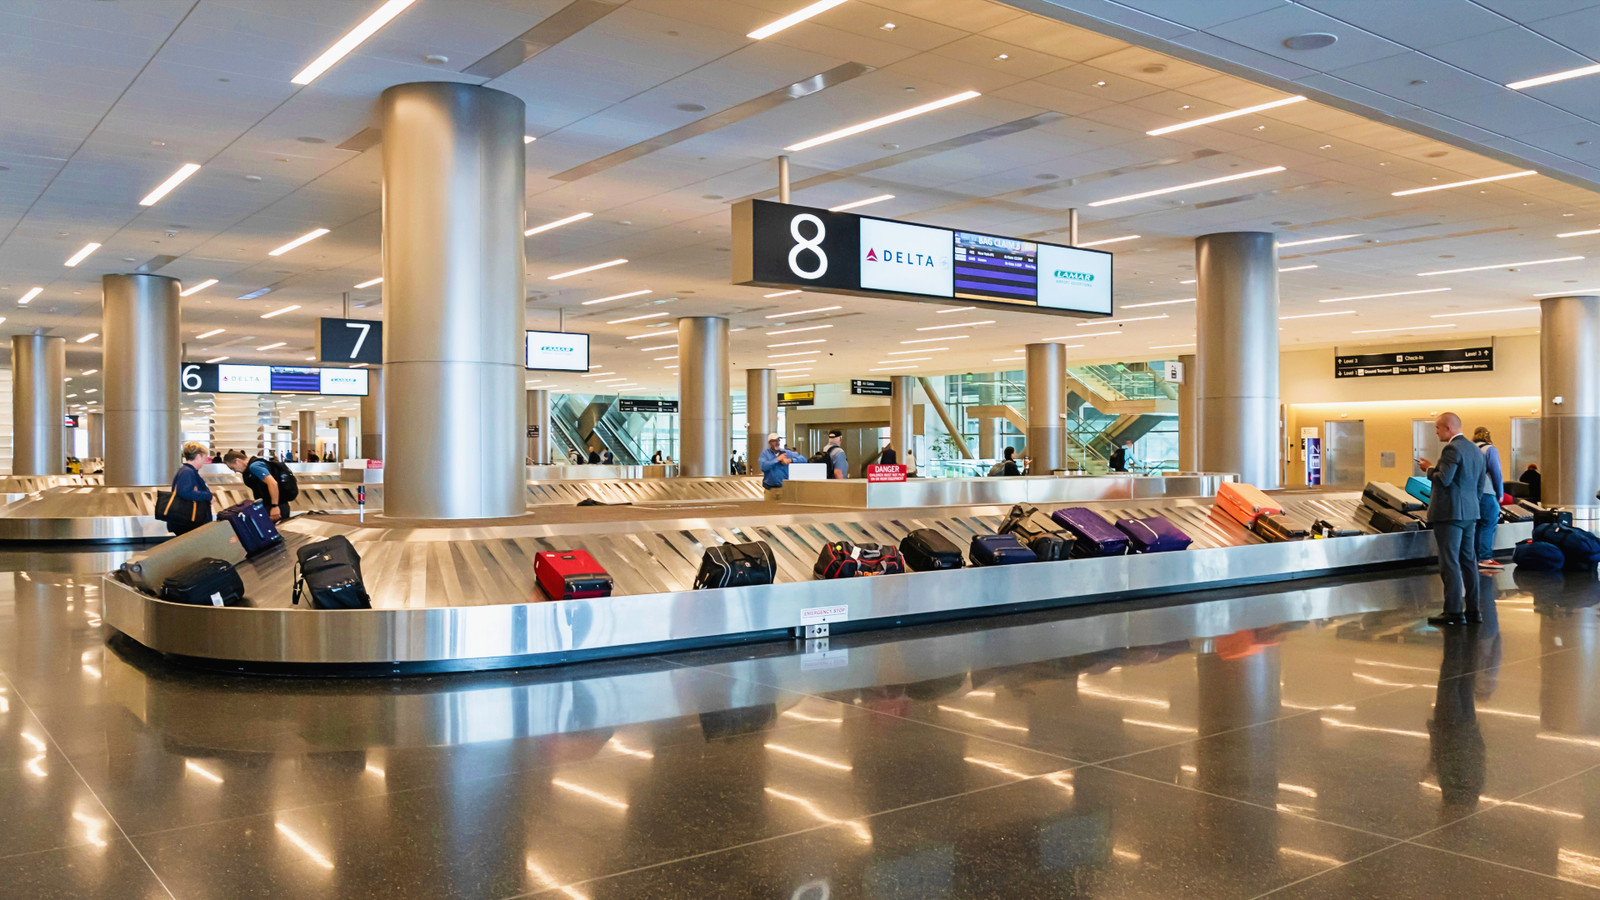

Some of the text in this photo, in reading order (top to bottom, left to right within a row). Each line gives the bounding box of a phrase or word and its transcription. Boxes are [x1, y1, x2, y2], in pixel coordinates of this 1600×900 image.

[788, 213, 828, 280] 8
[978, 236, 993, 246] BAG
[993, 238, 1016, 250] CLAIM
[883, 249, 934, 267] DELTA
[1056, 270, 1092, 281] LAMAR
[346, 322, 371, 359] 7
[182, 364, 203, 391] 6
[875, 465, 900, 473] DANGER
